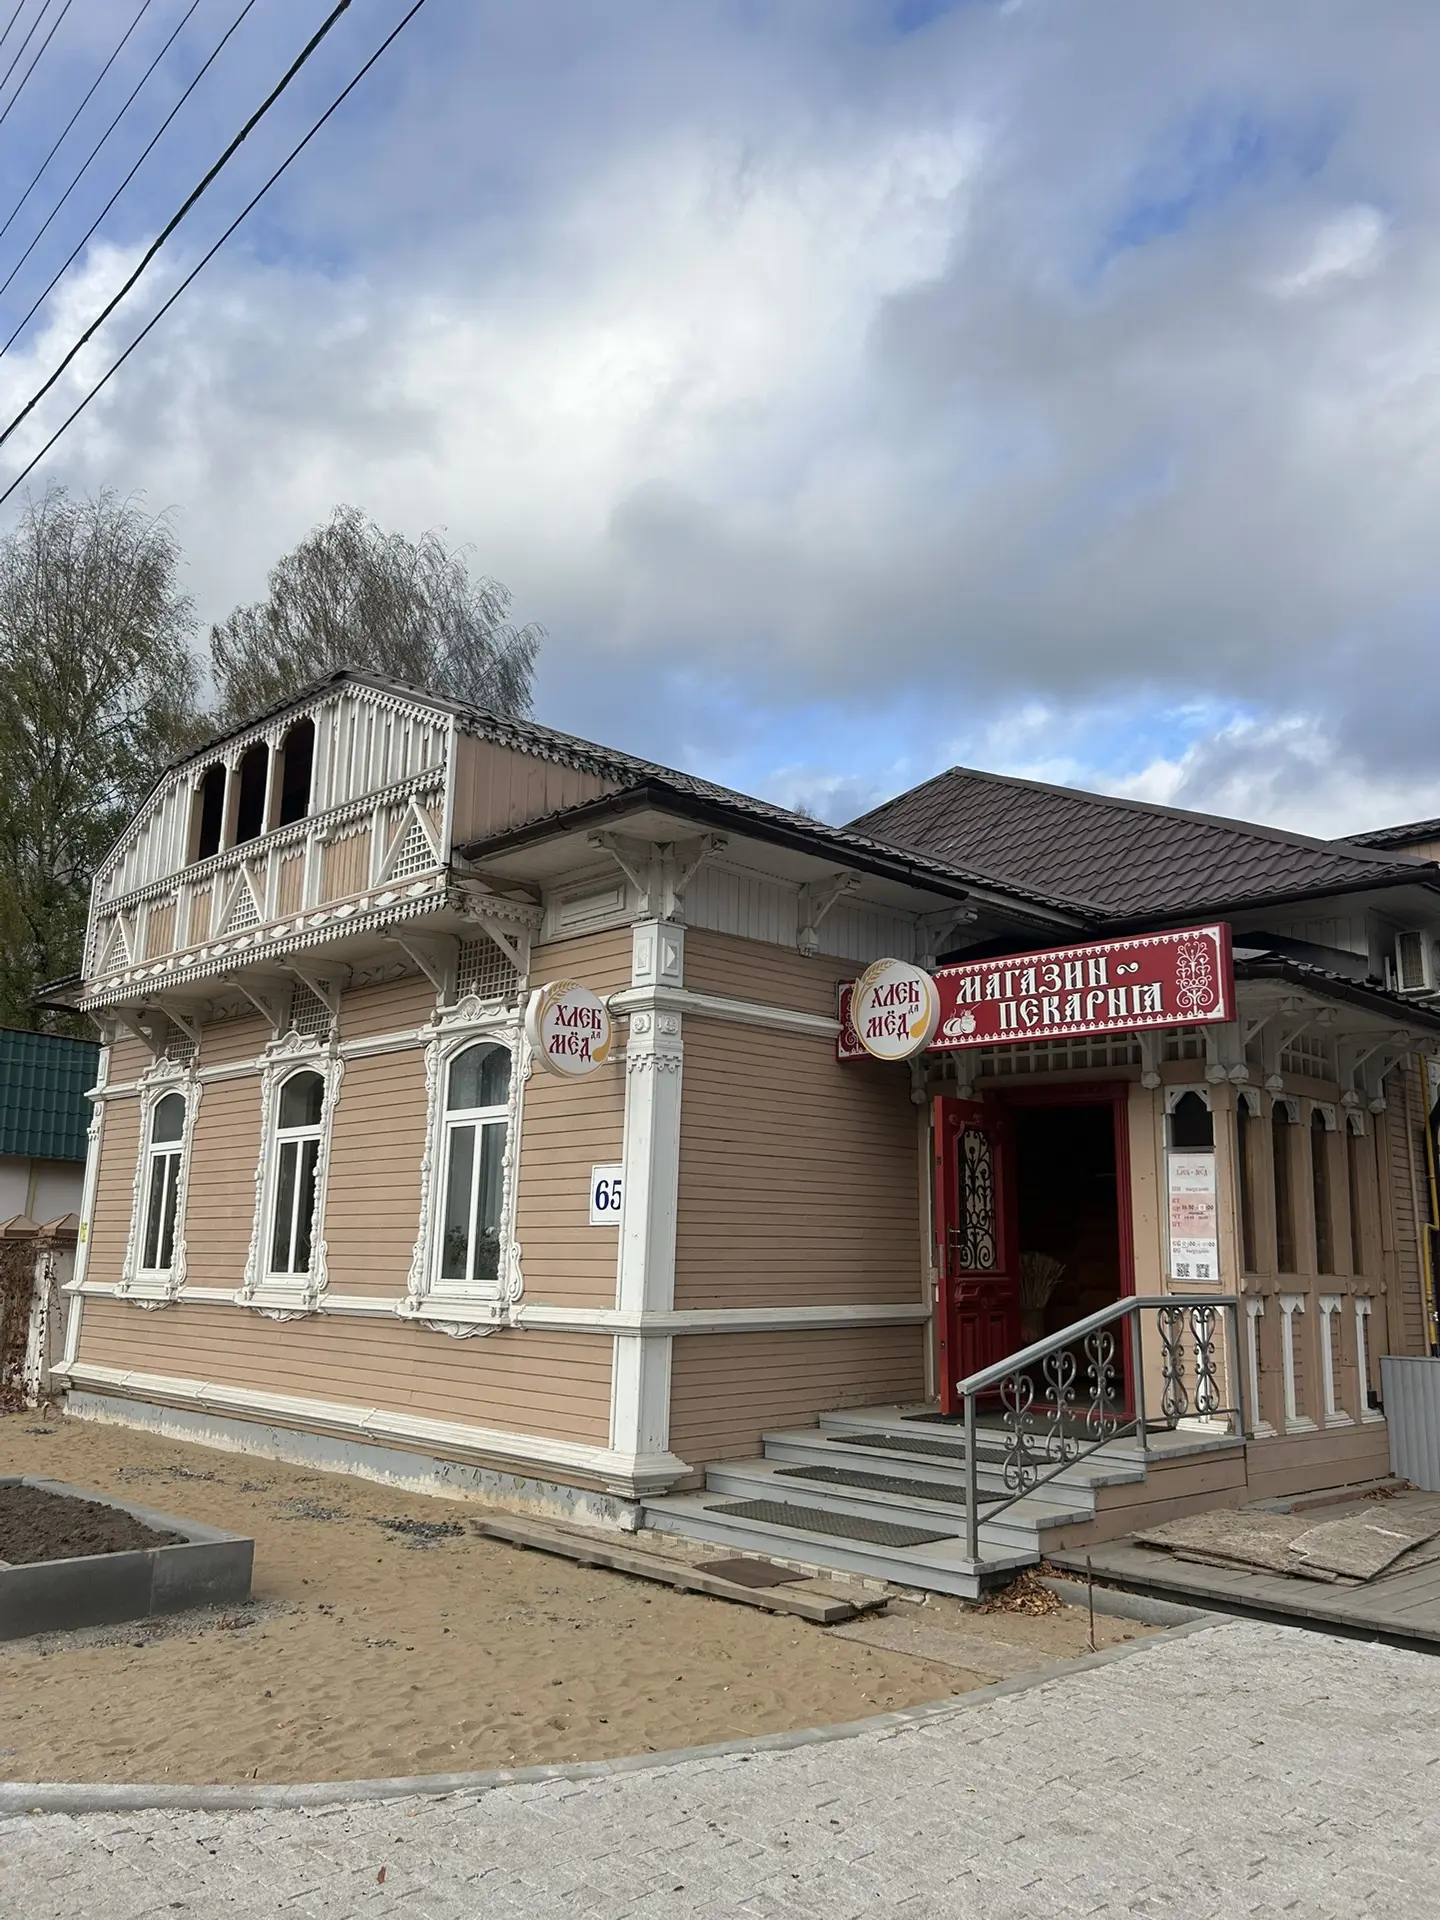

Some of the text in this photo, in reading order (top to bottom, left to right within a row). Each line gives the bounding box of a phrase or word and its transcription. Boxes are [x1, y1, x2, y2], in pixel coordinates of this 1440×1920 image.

[870, 980, 920, 1009] ХЛЕБ
[956, 957, 1109, 1005] МАГАЗИН
[554, 1004, 602, 1030] ХЛЕБ
[866, 1010, 910, 1041] МЁД
[549, 1031, 591, 1063] МЁД
[595, 1180, 622, 1211] 65
